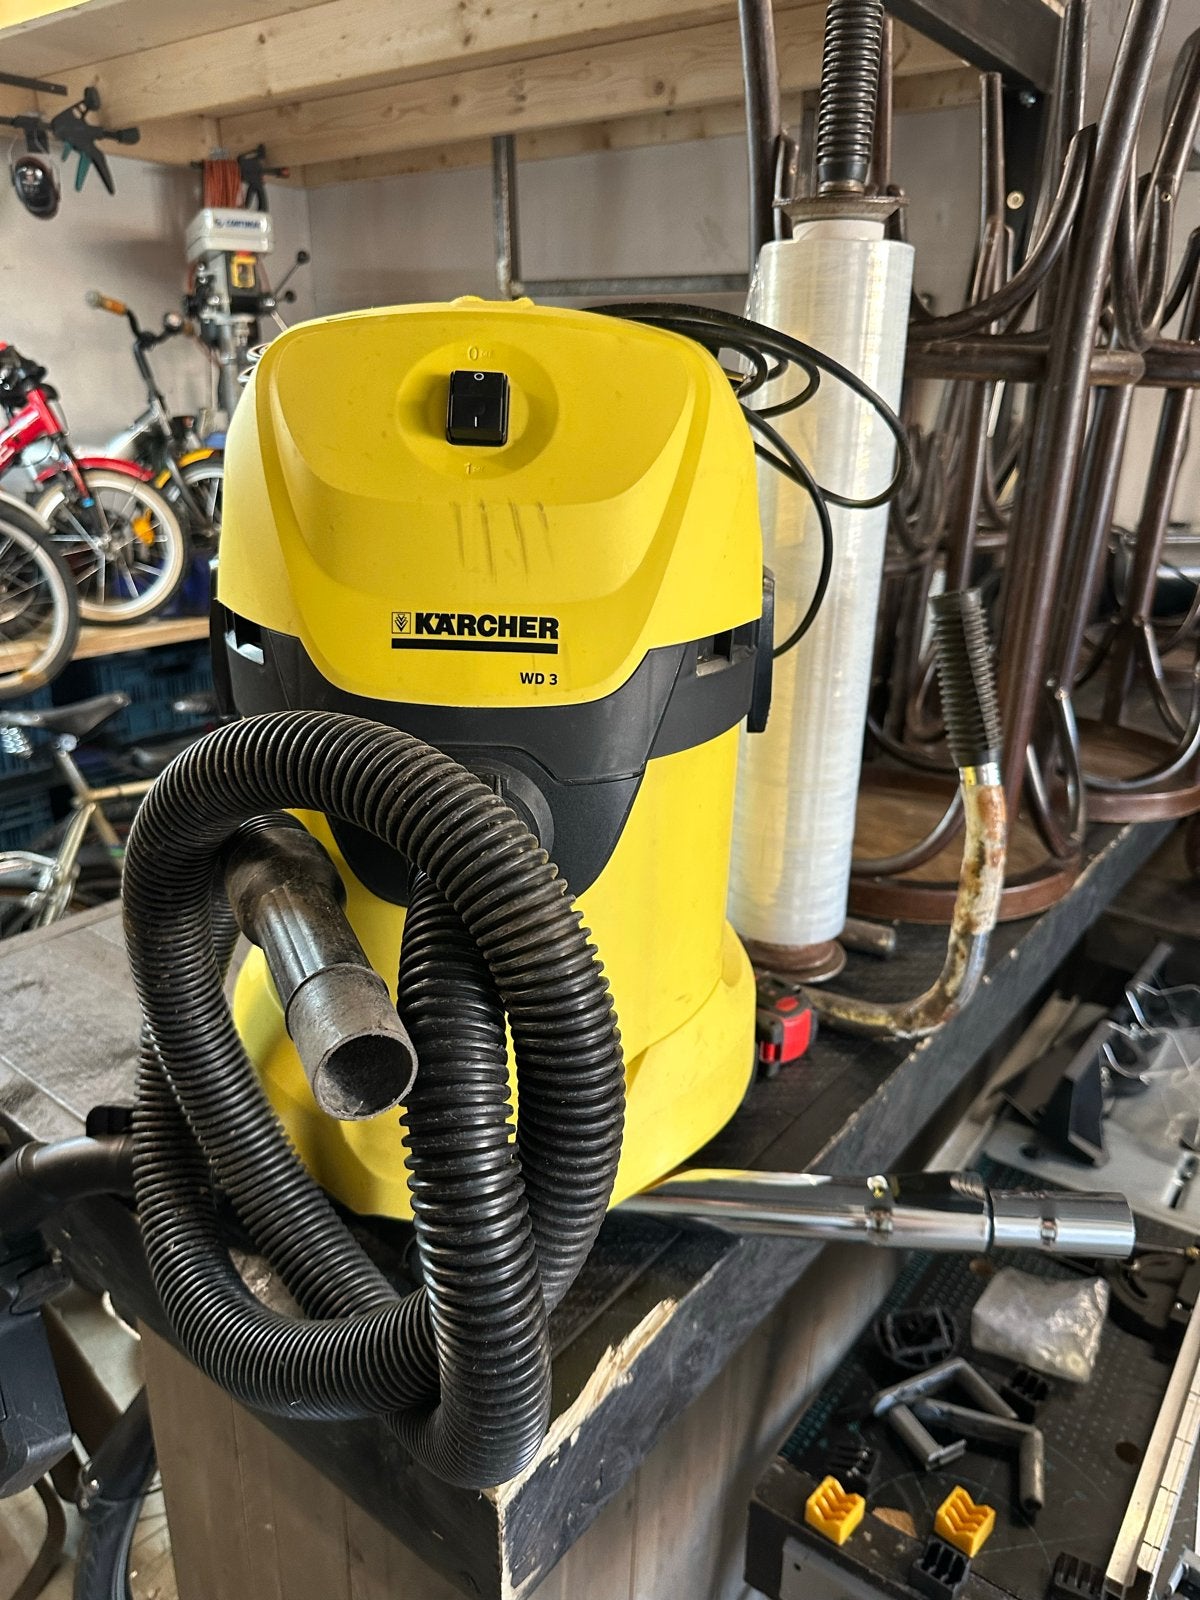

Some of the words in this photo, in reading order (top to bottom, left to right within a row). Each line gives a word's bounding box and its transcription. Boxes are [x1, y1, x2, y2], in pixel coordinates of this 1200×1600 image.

[415, 612, 559, 640] KÄRCHER
[520, 672, 545, 685] WD
[549, 673, 558, 685] 3
